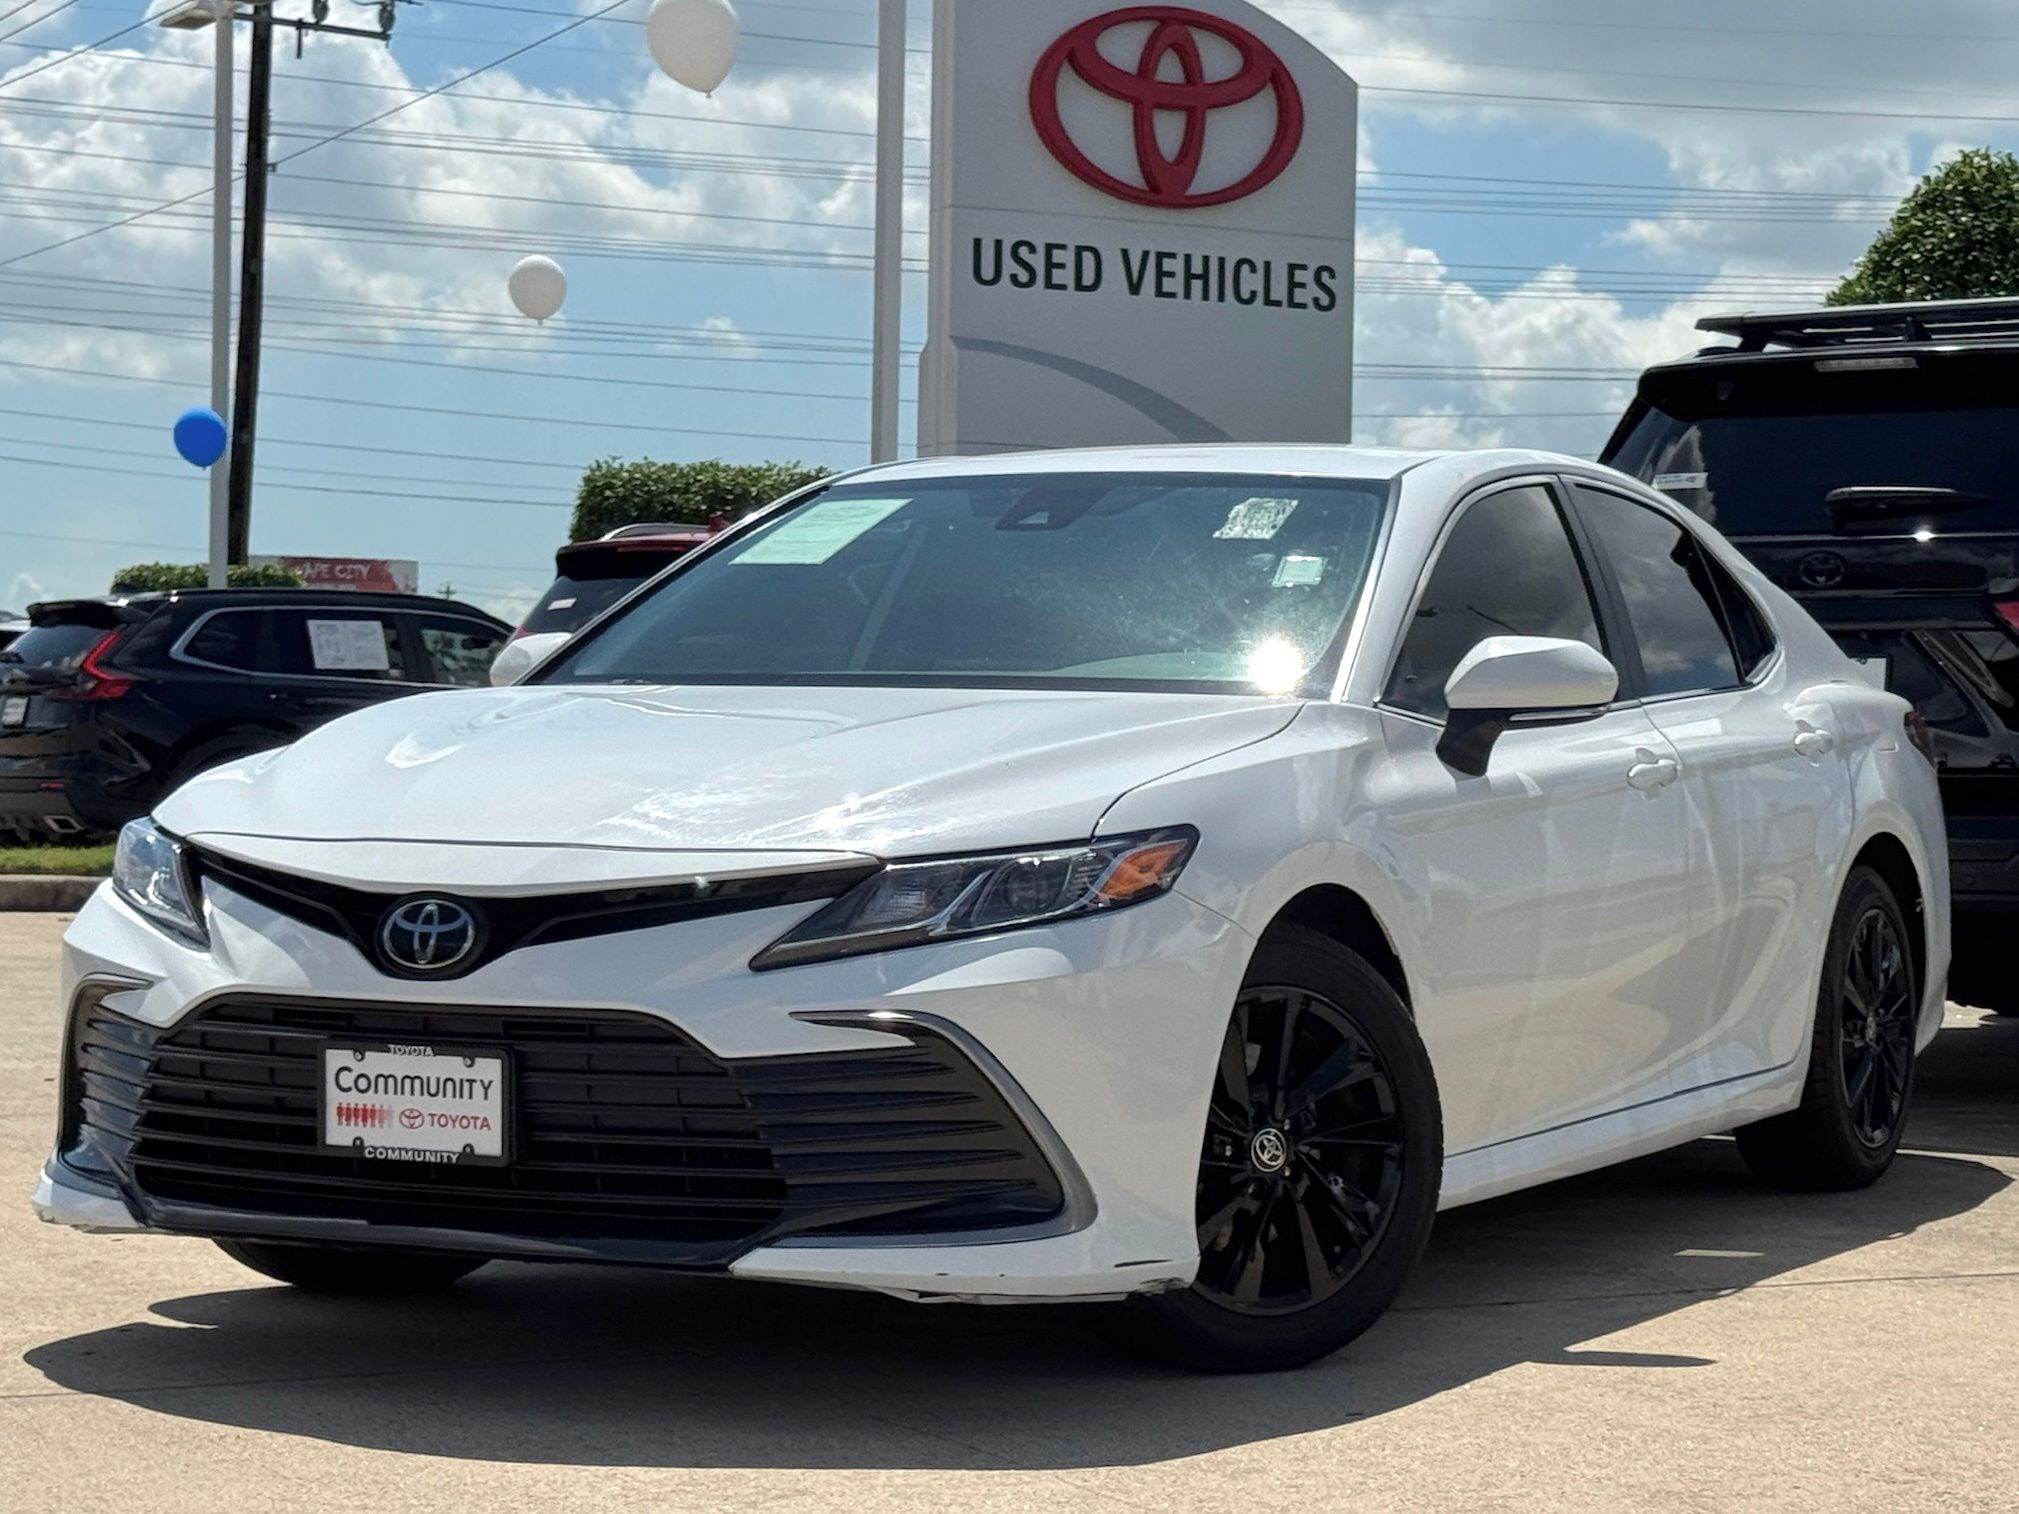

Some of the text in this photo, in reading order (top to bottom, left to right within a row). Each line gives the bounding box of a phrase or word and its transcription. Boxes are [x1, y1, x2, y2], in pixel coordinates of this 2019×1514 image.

[972, 237, 1337, 312] USED VEHICLES
[301, 561, 371, 579] APE CITY
[387, 1044, 434, 1057] TOYOTA
[428, 1112, 492, 1131] TOYOTA
[364, 1146, 460, 1164] COMMUNITY
